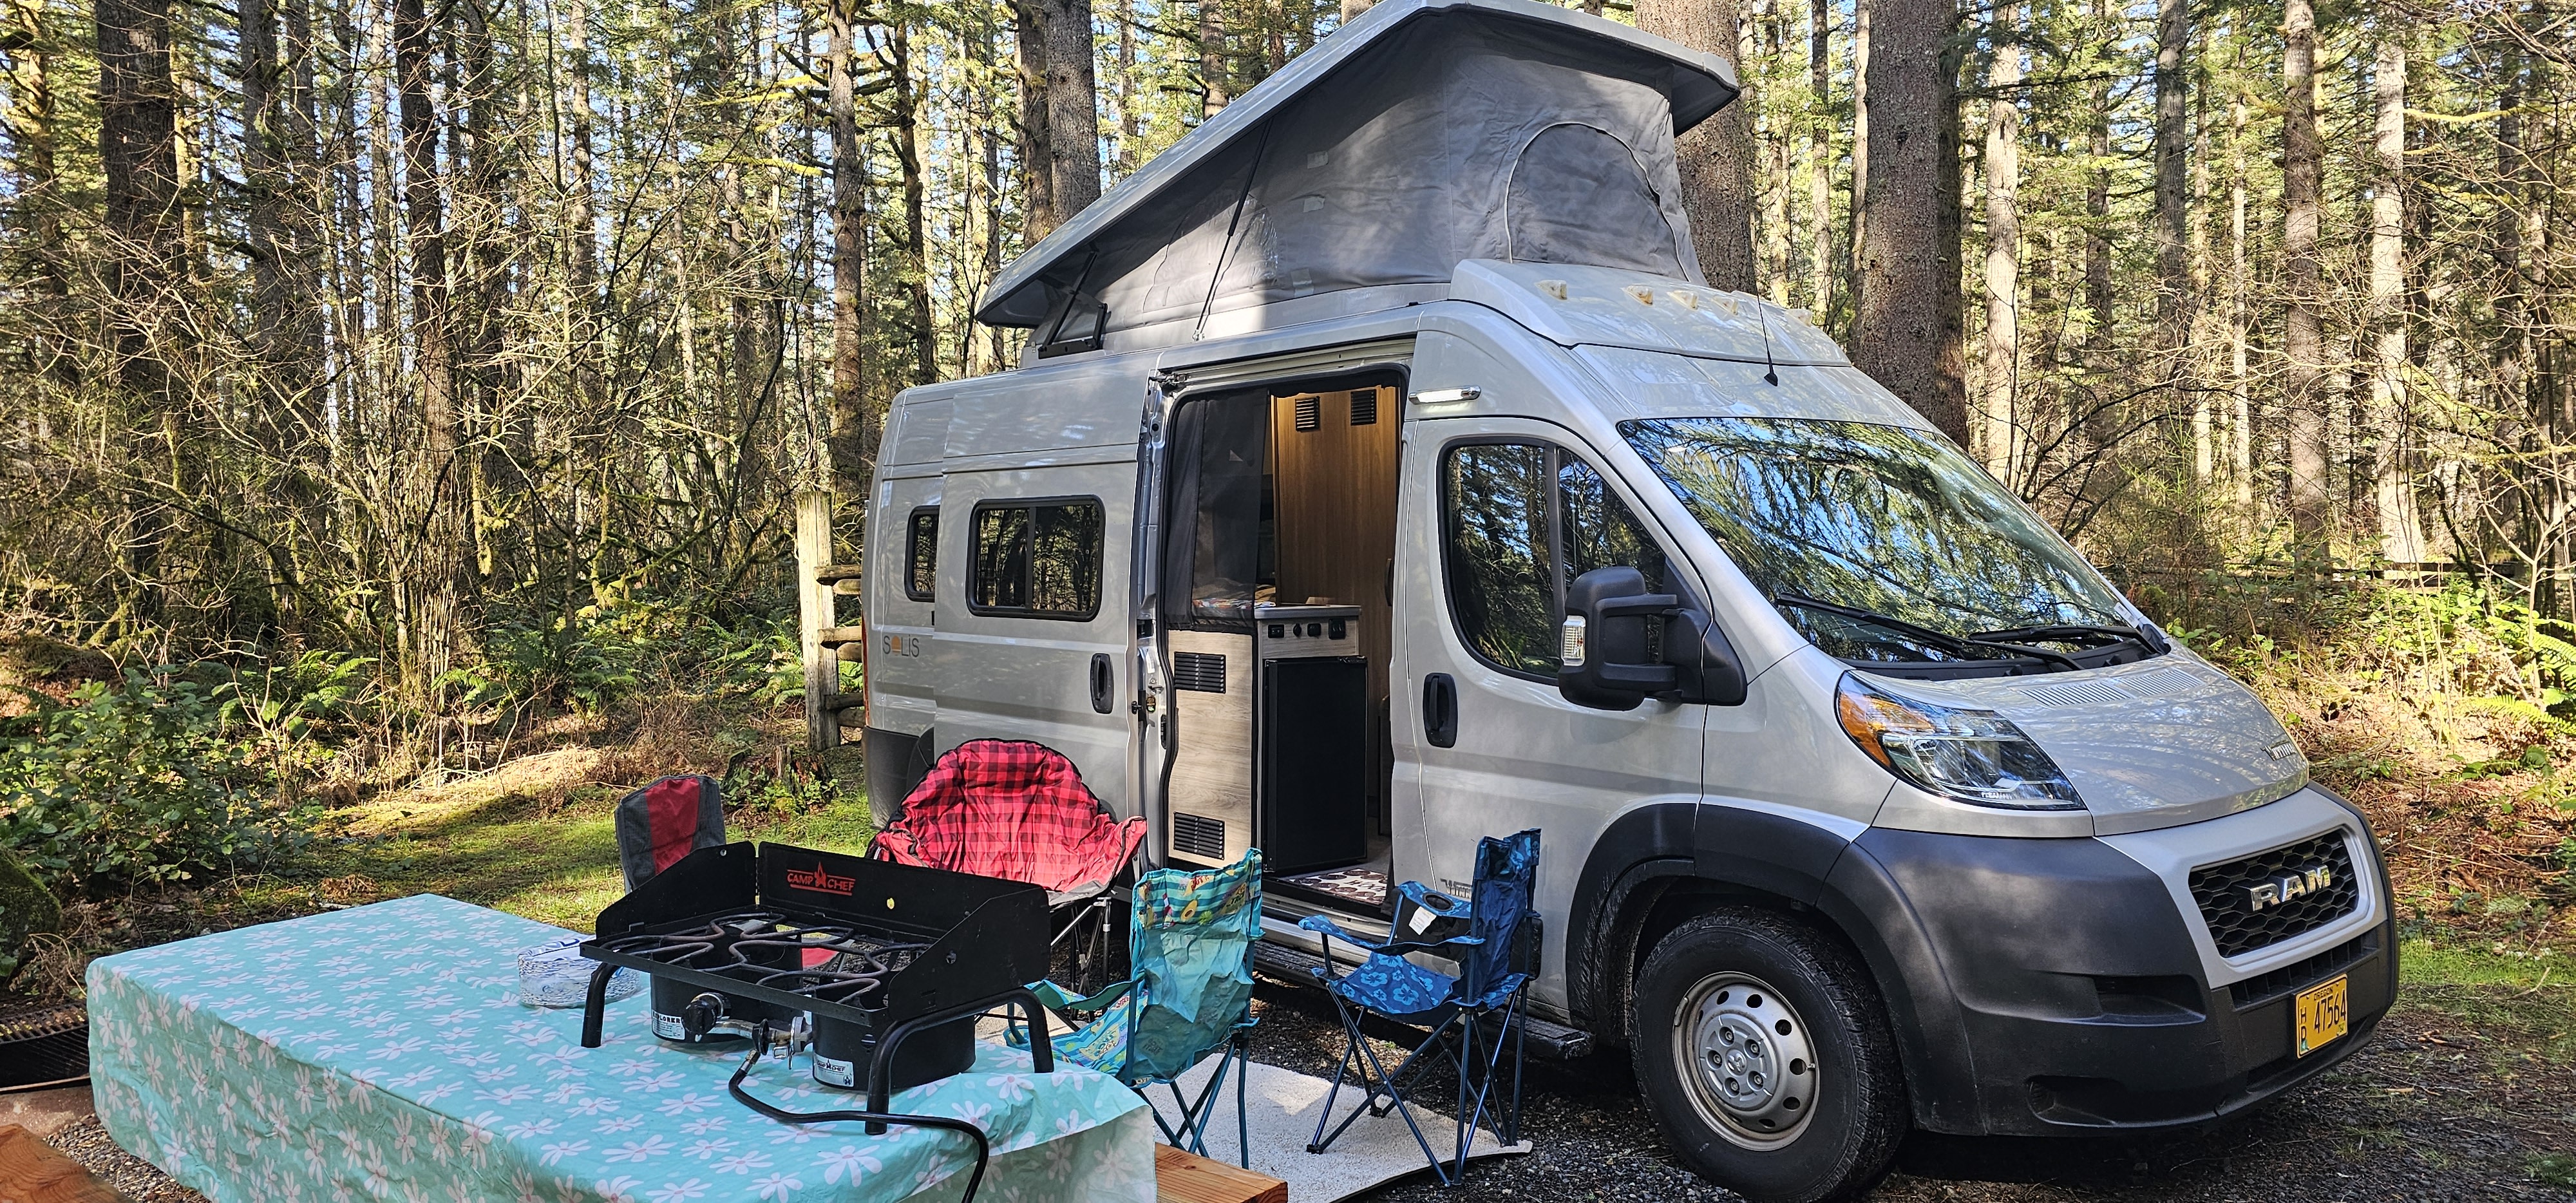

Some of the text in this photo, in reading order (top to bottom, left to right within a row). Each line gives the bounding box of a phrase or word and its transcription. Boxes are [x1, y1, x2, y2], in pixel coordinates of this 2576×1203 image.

[787, 873, 855, 891] CAMP CHEF
[2249, 864, 2331, 912] RAM
[2313, 986, 2334, 1001] OREGON
[2314, 989, 2347, 1034] 47564
